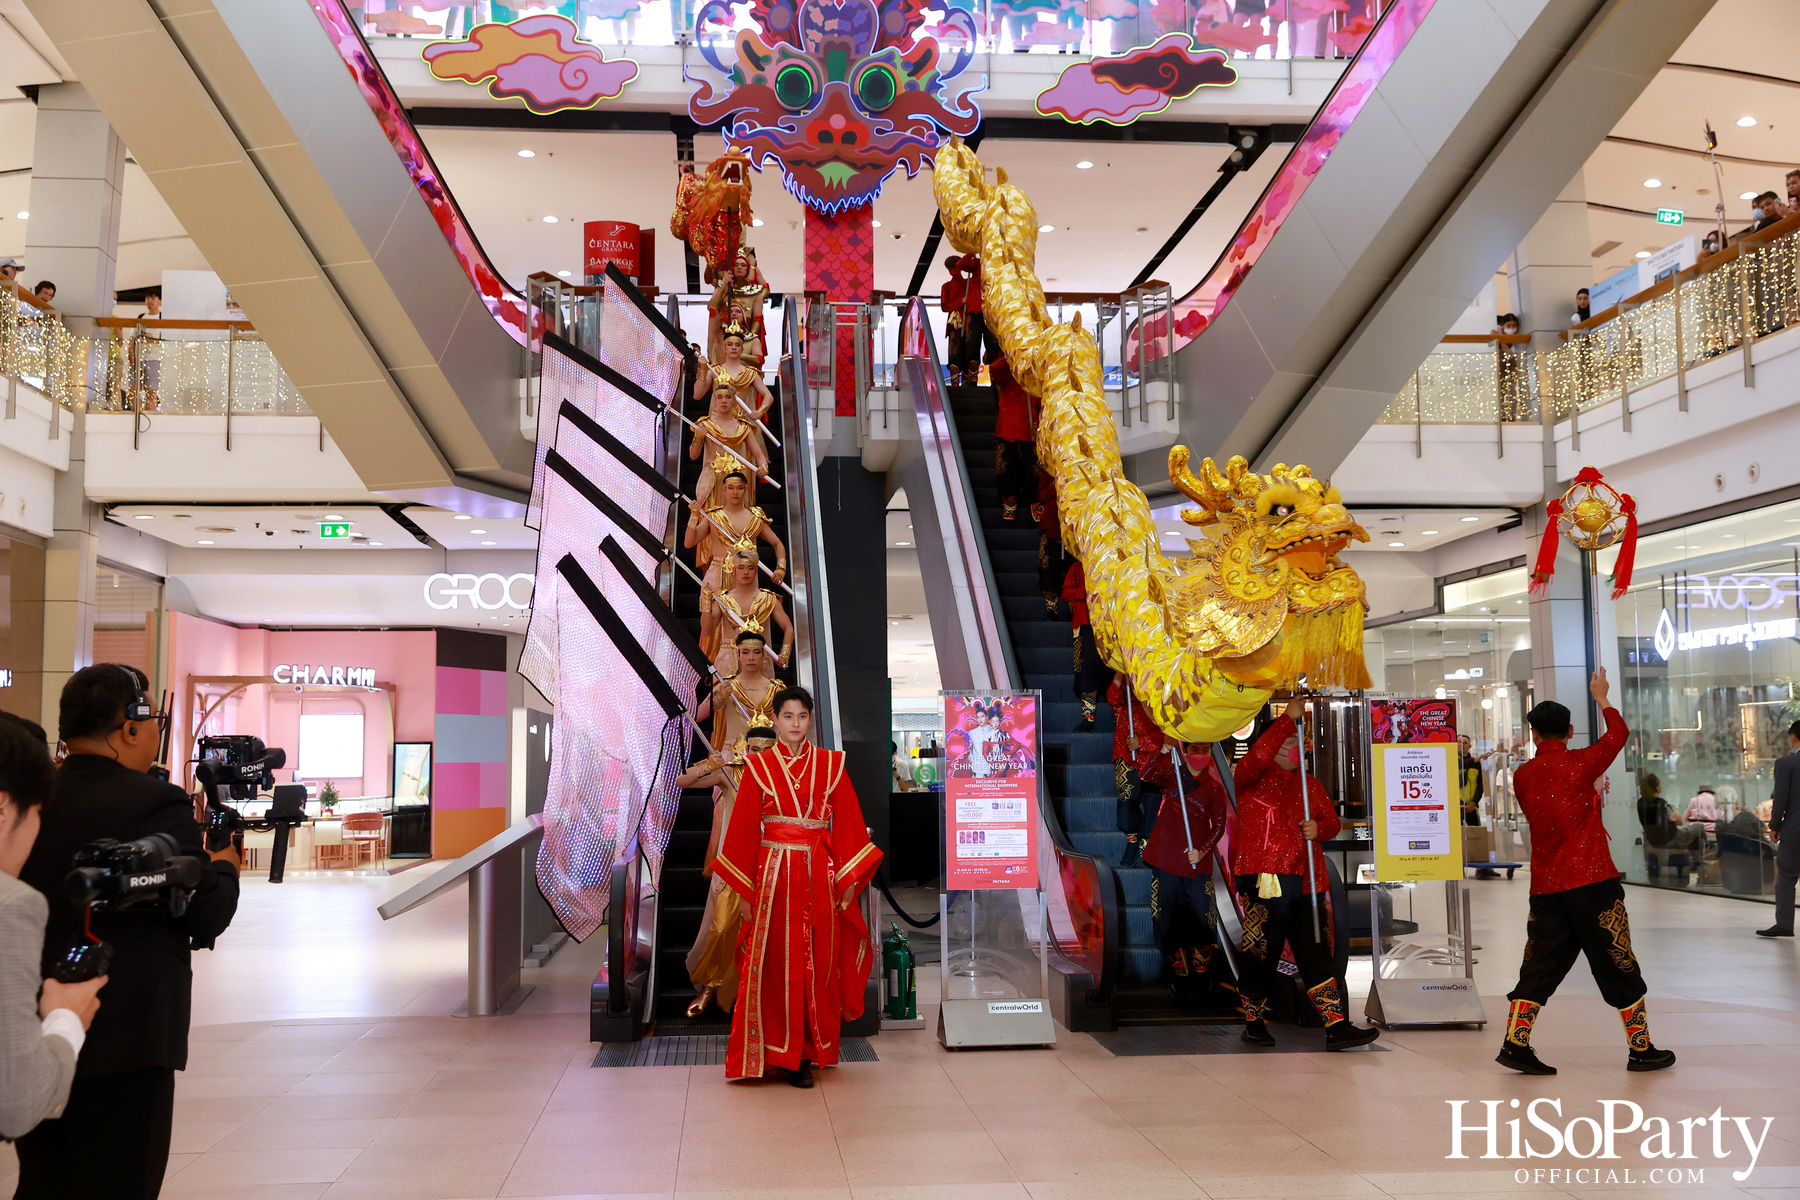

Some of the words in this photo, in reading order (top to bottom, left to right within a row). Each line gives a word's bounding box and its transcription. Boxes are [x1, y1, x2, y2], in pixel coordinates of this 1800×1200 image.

[589, 238, 634, 250] CENTARA
[423, 572, 536, 610] GROO
[986, 754, 1012, 762] GREAT
[241, 762, 265, 774] RONIN
[1008, 762, 1028, 770] YEAR
[1400, 763, 1432, 773] แลกรับ
[130, 873, 167, 888] RONIN
